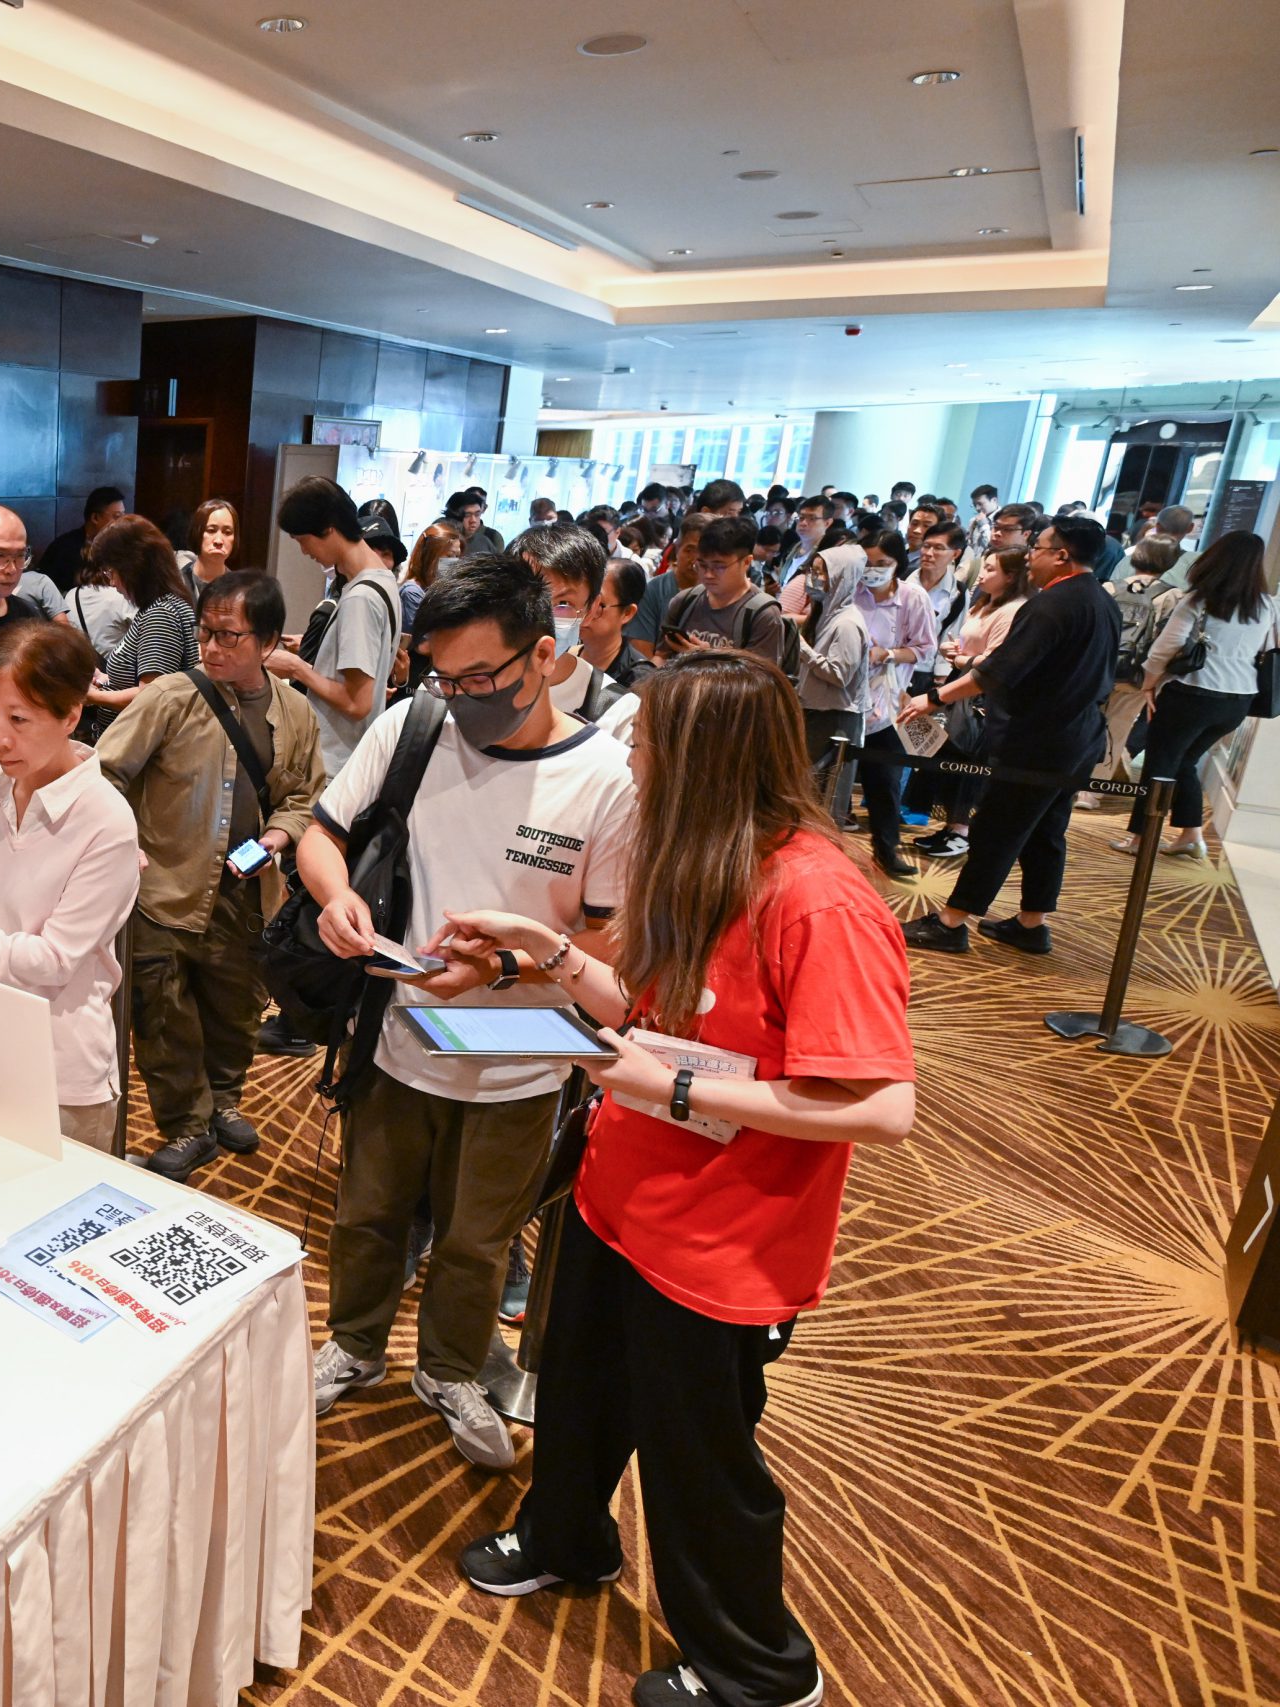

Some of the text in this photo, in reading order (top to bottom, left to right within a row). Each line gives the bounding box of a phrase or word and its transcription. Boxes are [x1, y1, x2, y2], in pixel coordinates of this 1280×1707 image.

[939, 761, 992, 776] CORDIS
[1089, 780, 1148, 796] CORDIS
[516, 825, 585, 852] SOUTHSIDE
[537, 845, 552, 855] OF
[506, 848, 575, 876] TENNESSEE
[185, 1211, 270, 1264] 現場登記
[67, 1260, 170, 1334] 招聘及進修日2026
[79, 1307, 107, 1320] JUMP
[159, 1311, 187, 1326] JUMP
